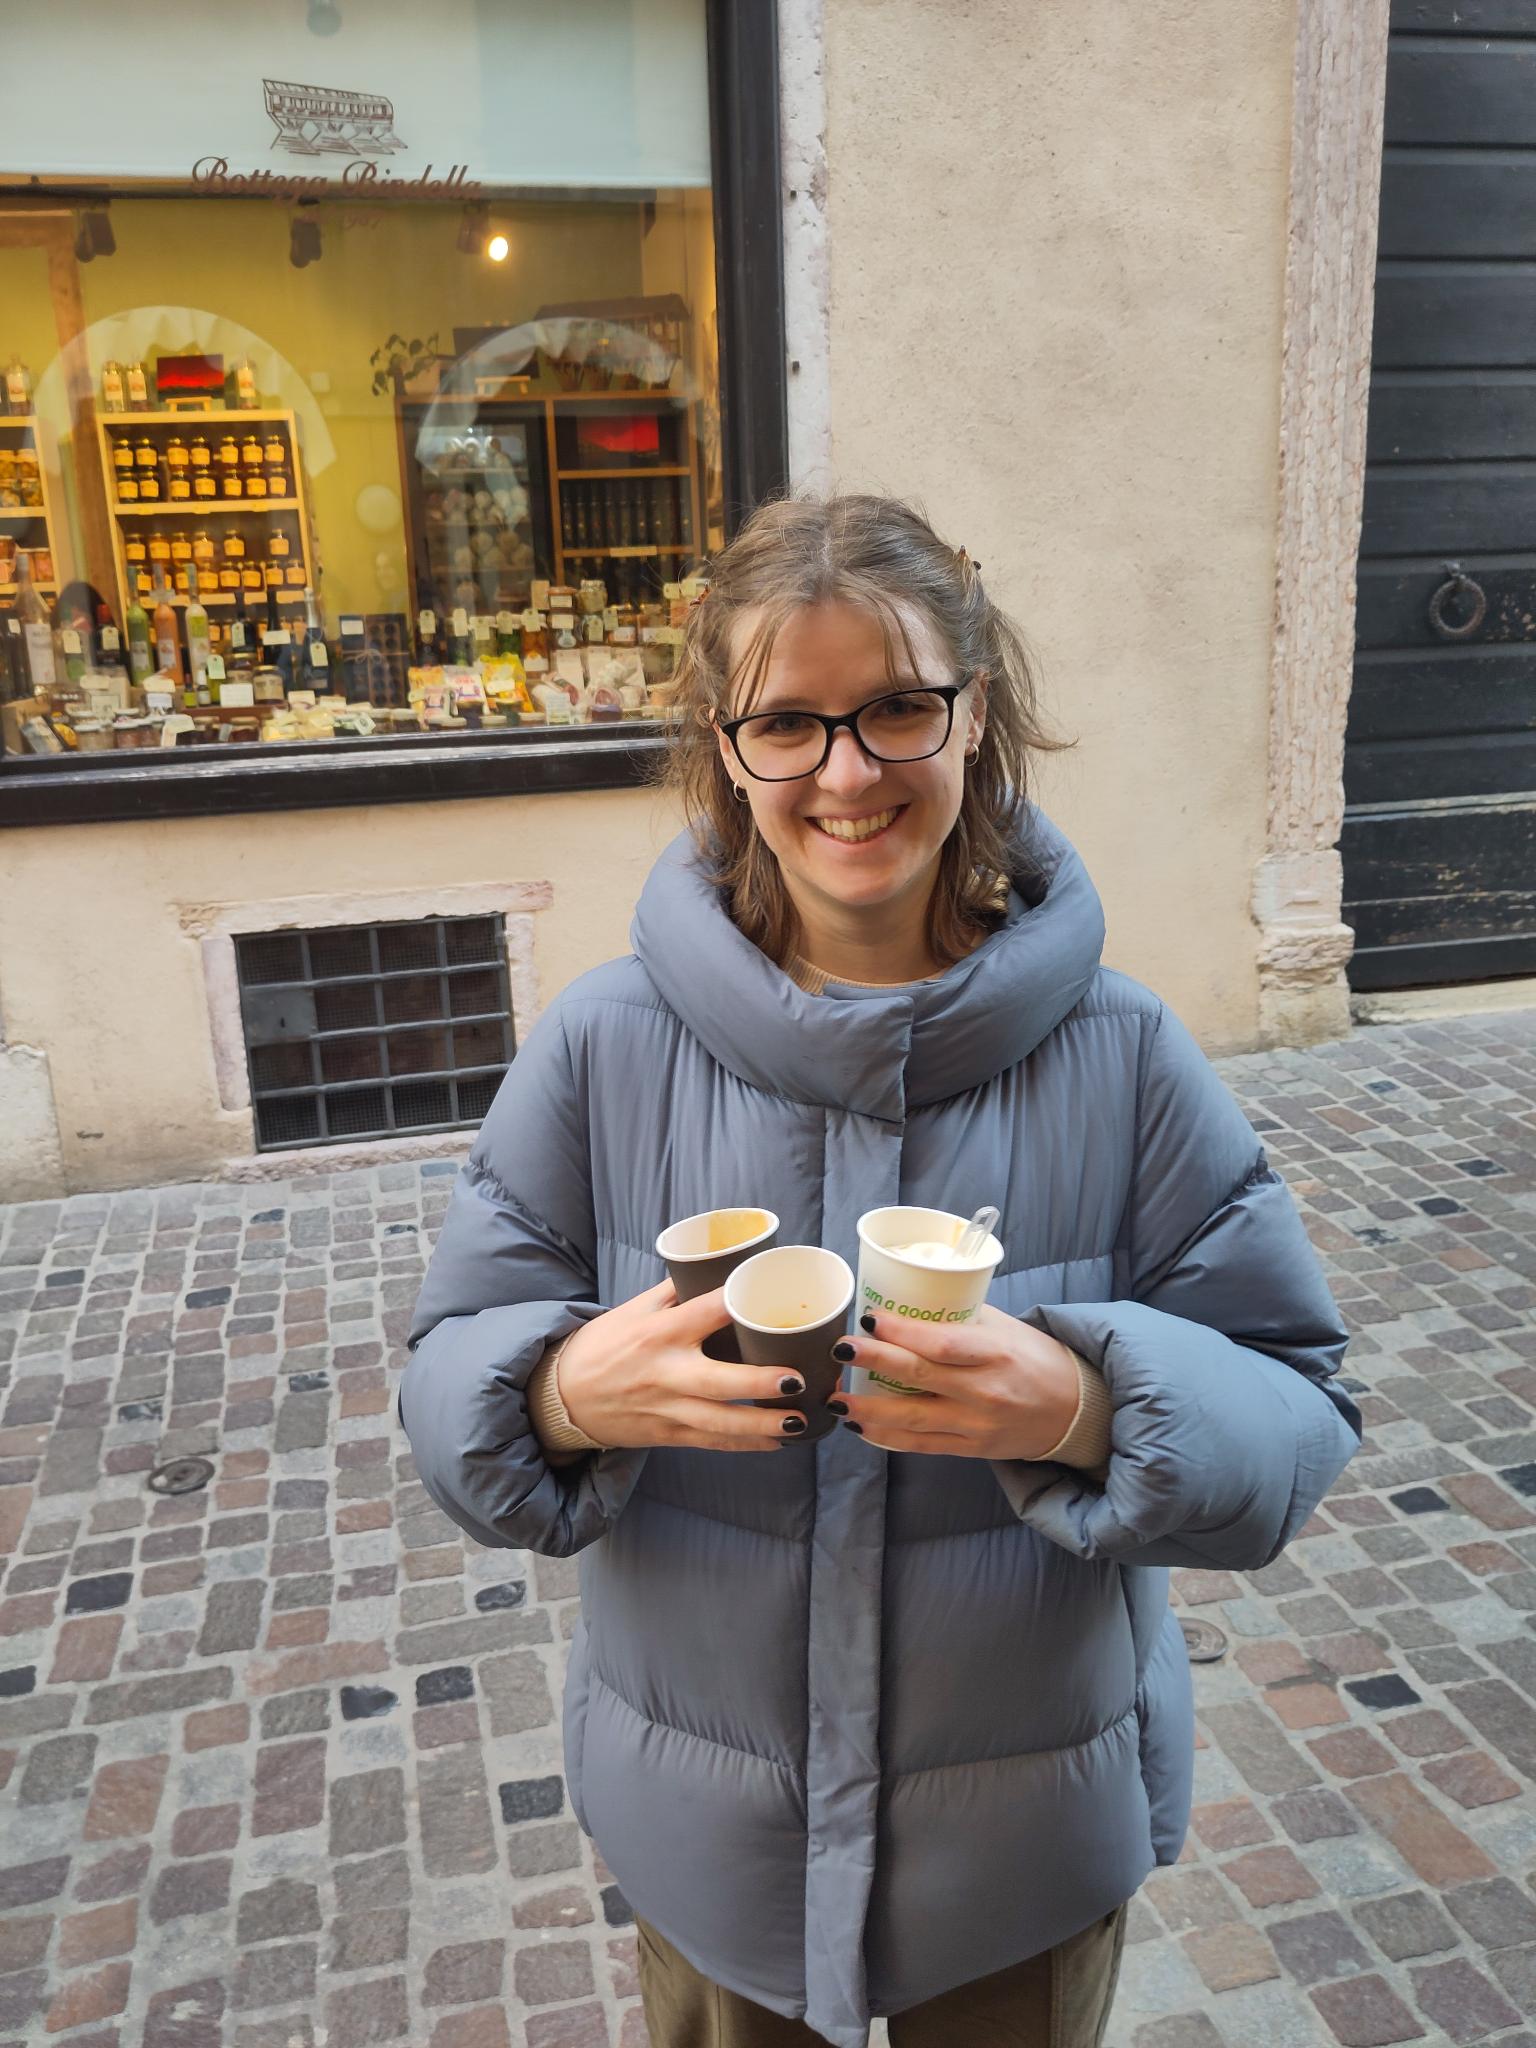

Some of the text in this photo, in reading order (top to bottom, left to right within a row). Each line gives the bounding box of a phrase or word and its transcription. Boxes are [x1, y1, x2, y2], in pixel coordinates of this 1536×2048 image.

[192, 156, 328, 205] Bottega
[864, 1286, 883, 1305] am
[885, 1299, 896, 1311] a
[898, 1304, 946, 1322] good
